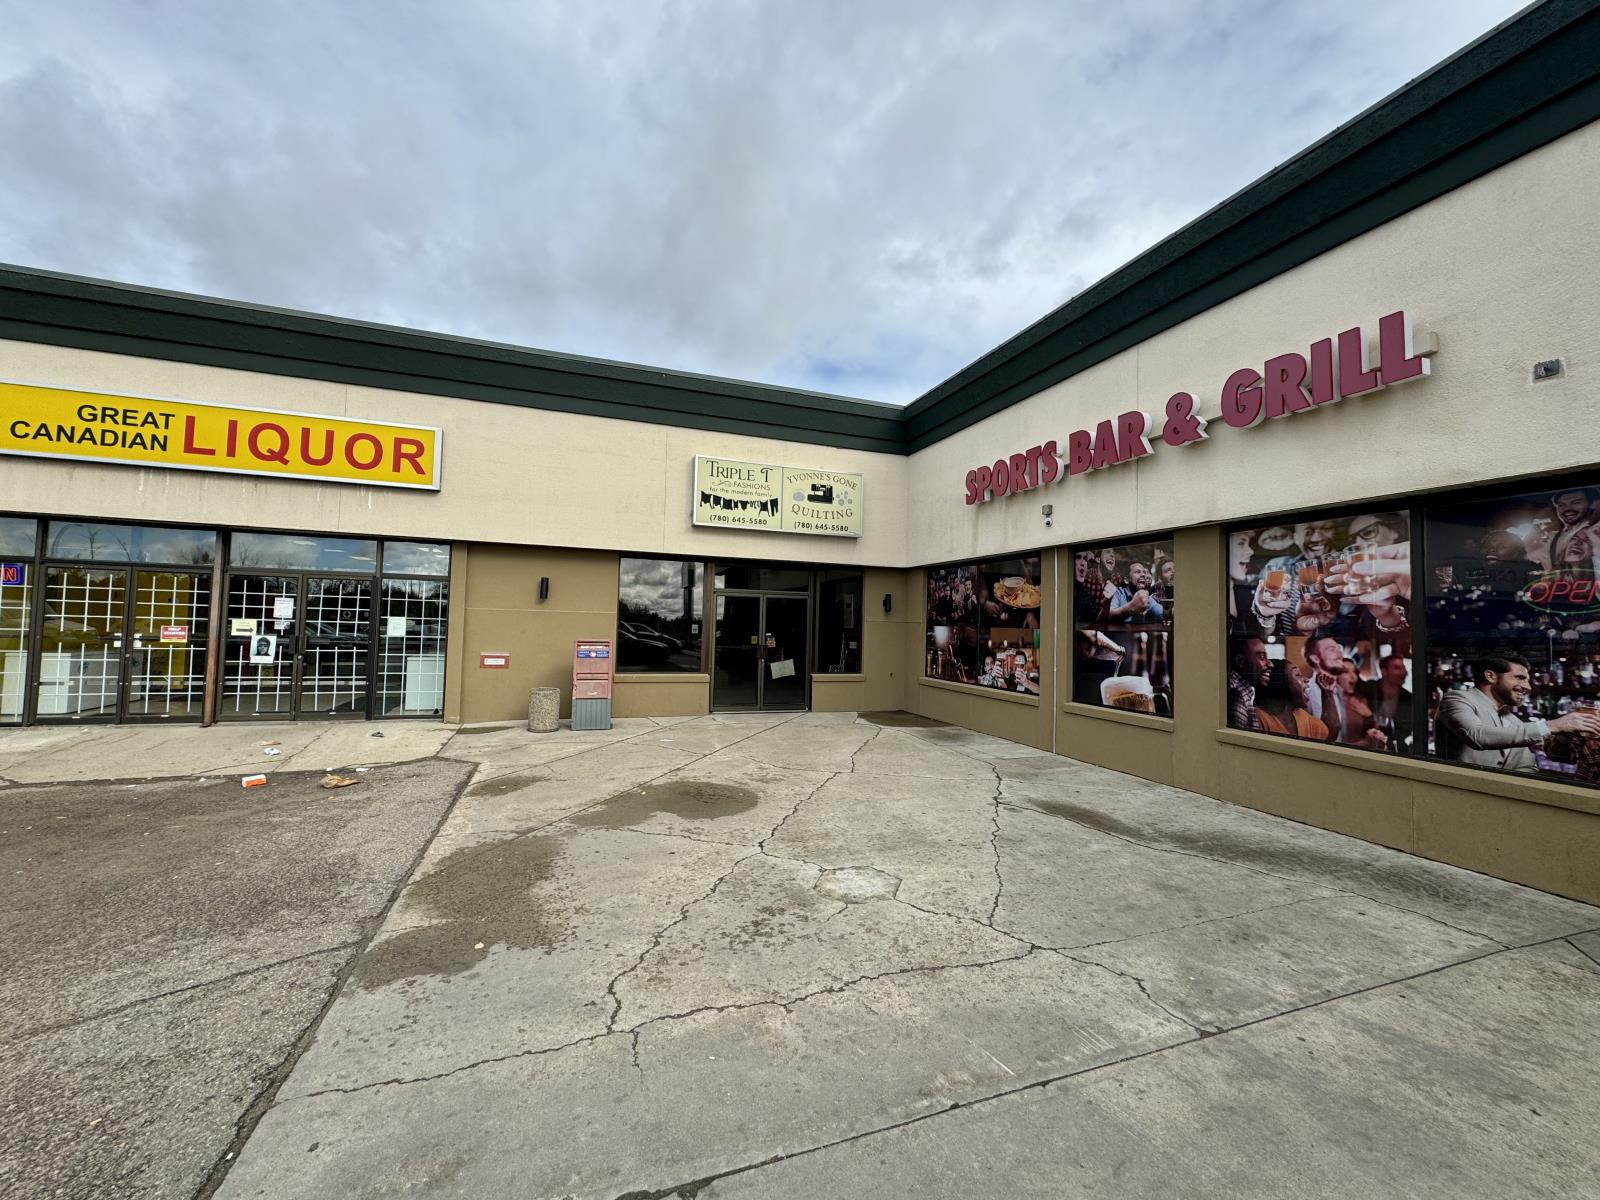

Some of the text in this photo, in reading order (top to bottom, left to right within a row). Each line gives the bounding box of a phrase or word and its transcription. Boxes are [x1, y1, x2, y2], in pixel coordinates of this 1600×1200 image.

[76, 403, 176, 430] GREAT
[965, 310, 1426, 506] SPORTS BAR & GRILL
[9, 420, 169, 452] CANADIAN
[182, 414, 427, 476] LIQUOR
[706, 460, 773, 483] TRIPLE T
[733, 481, 771, 491] FASHIONS
[786, 472, 858, 491] YVONNE'S GONE
[731, 489, 754, 497] modern
[754, 490, 773, 499] family
[709, 514, 768, 526] (780) 645-5580
[791, 503, 854, 520] QUILTING
[793, 521, 849, 532] (780) 645-5580
